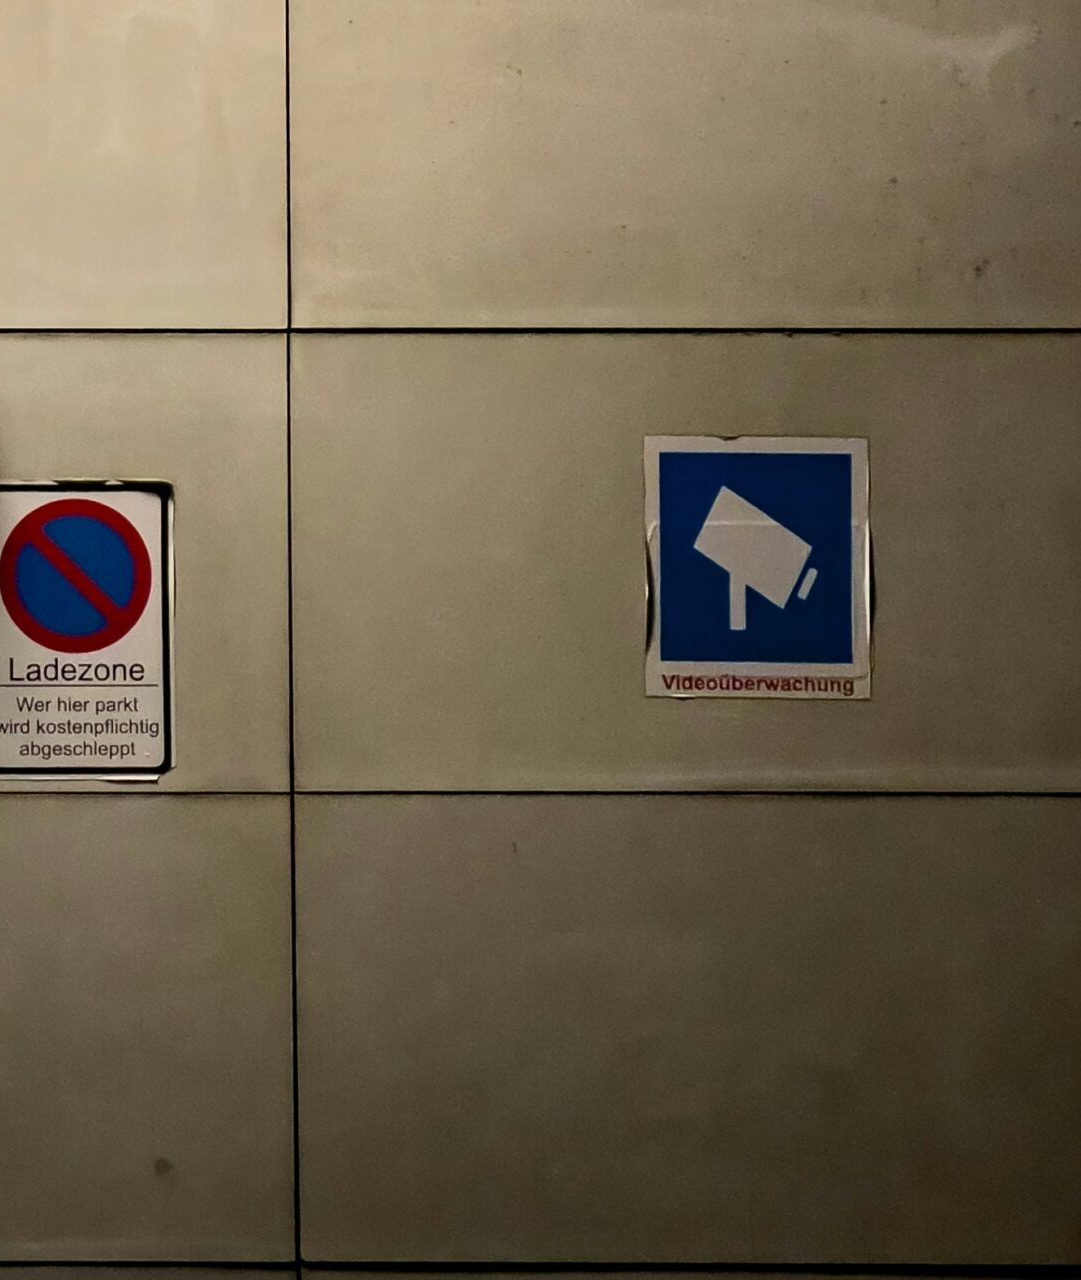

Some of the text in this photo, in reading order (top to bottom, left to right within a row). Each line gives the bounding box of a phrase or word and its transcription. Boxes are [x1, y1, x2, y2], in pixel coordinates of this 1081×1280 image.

[9, 657, 145, 682] Ladezone
[661, 673, 855, 697] Videoüberwachung
[16, 696, 139, 715] Wer hier parkt
[36, 719, 160, 738] kostenpflichtig
[19, 741, 136, 760] abgeschleppt
